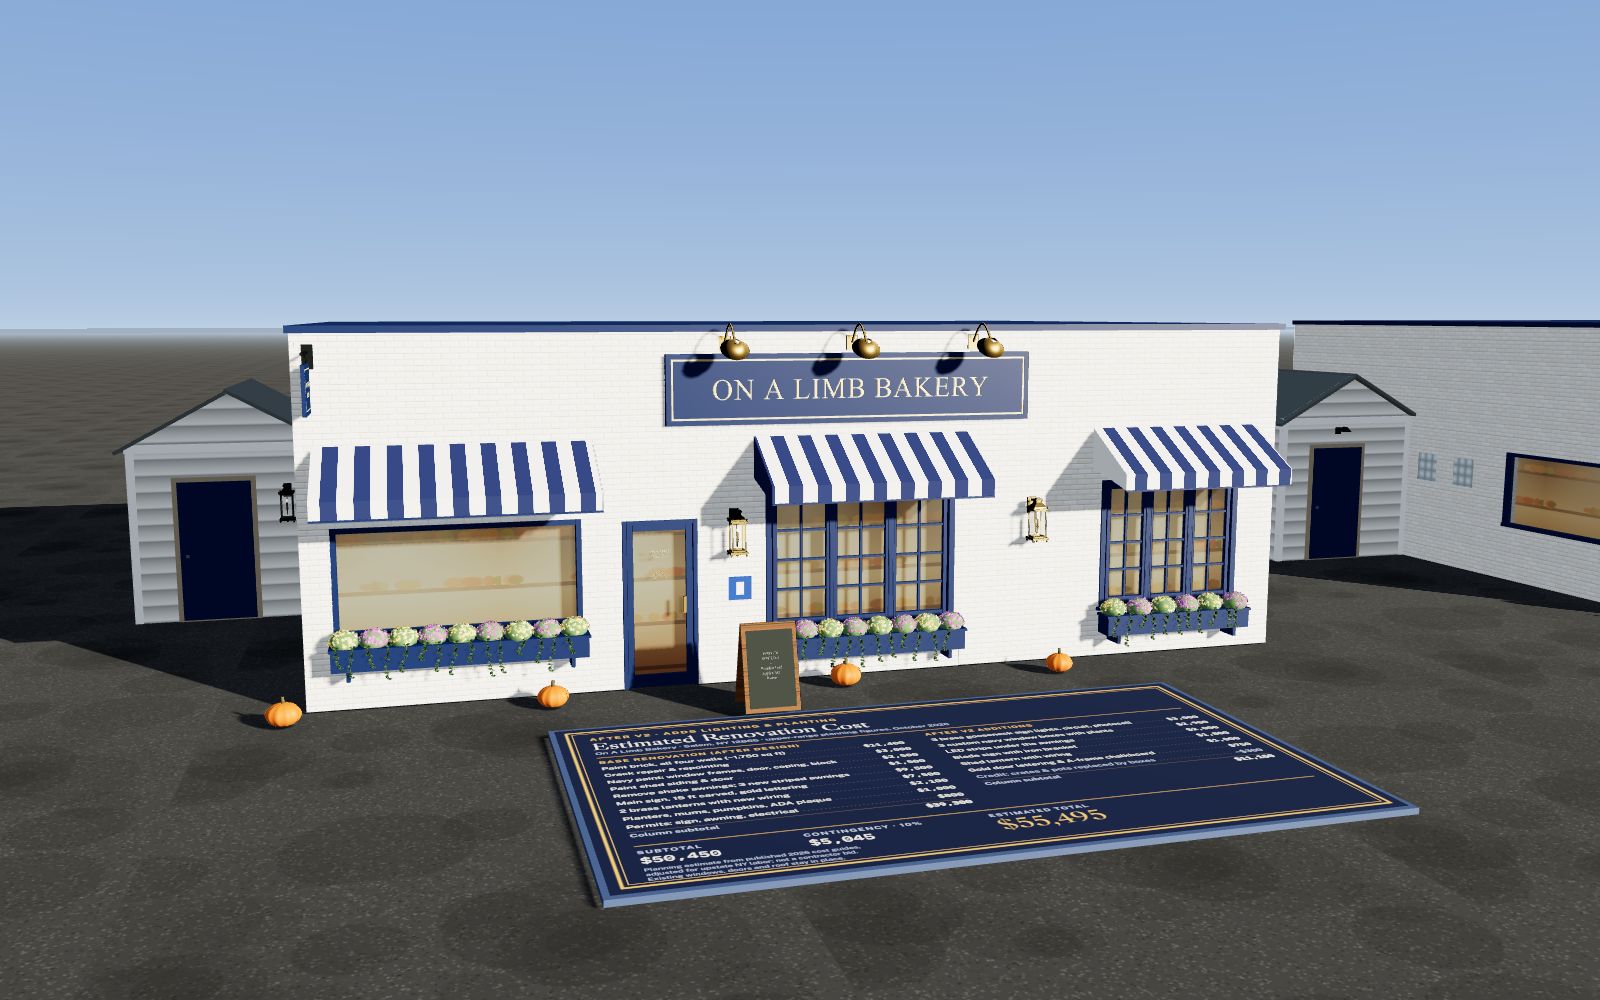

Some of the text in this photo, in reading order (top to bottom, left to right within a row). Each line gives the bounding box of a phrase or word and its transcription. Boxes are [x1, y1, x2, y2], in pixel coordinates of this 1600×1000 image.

[712, 376, 988, 401] ON A LIMB BAKERY
[593, 722, 870, 750] Estimated Renovation Cost
[713, 804, 768, 813] pumpkins,
[748, 808, 799, 817] electrical
[988, 807, 1051, 818] ESTIMATED
[998, 809, 1106, 829] $55,495
[675, 825, 720, 833] subtotal
[803, 825, 887, 837] CONTINGENCY
[809, 833, 875, 846] $5,045
[637, 845, 702, 855] SUBTOTAL
[640, 850, 721, 864] $50,450
